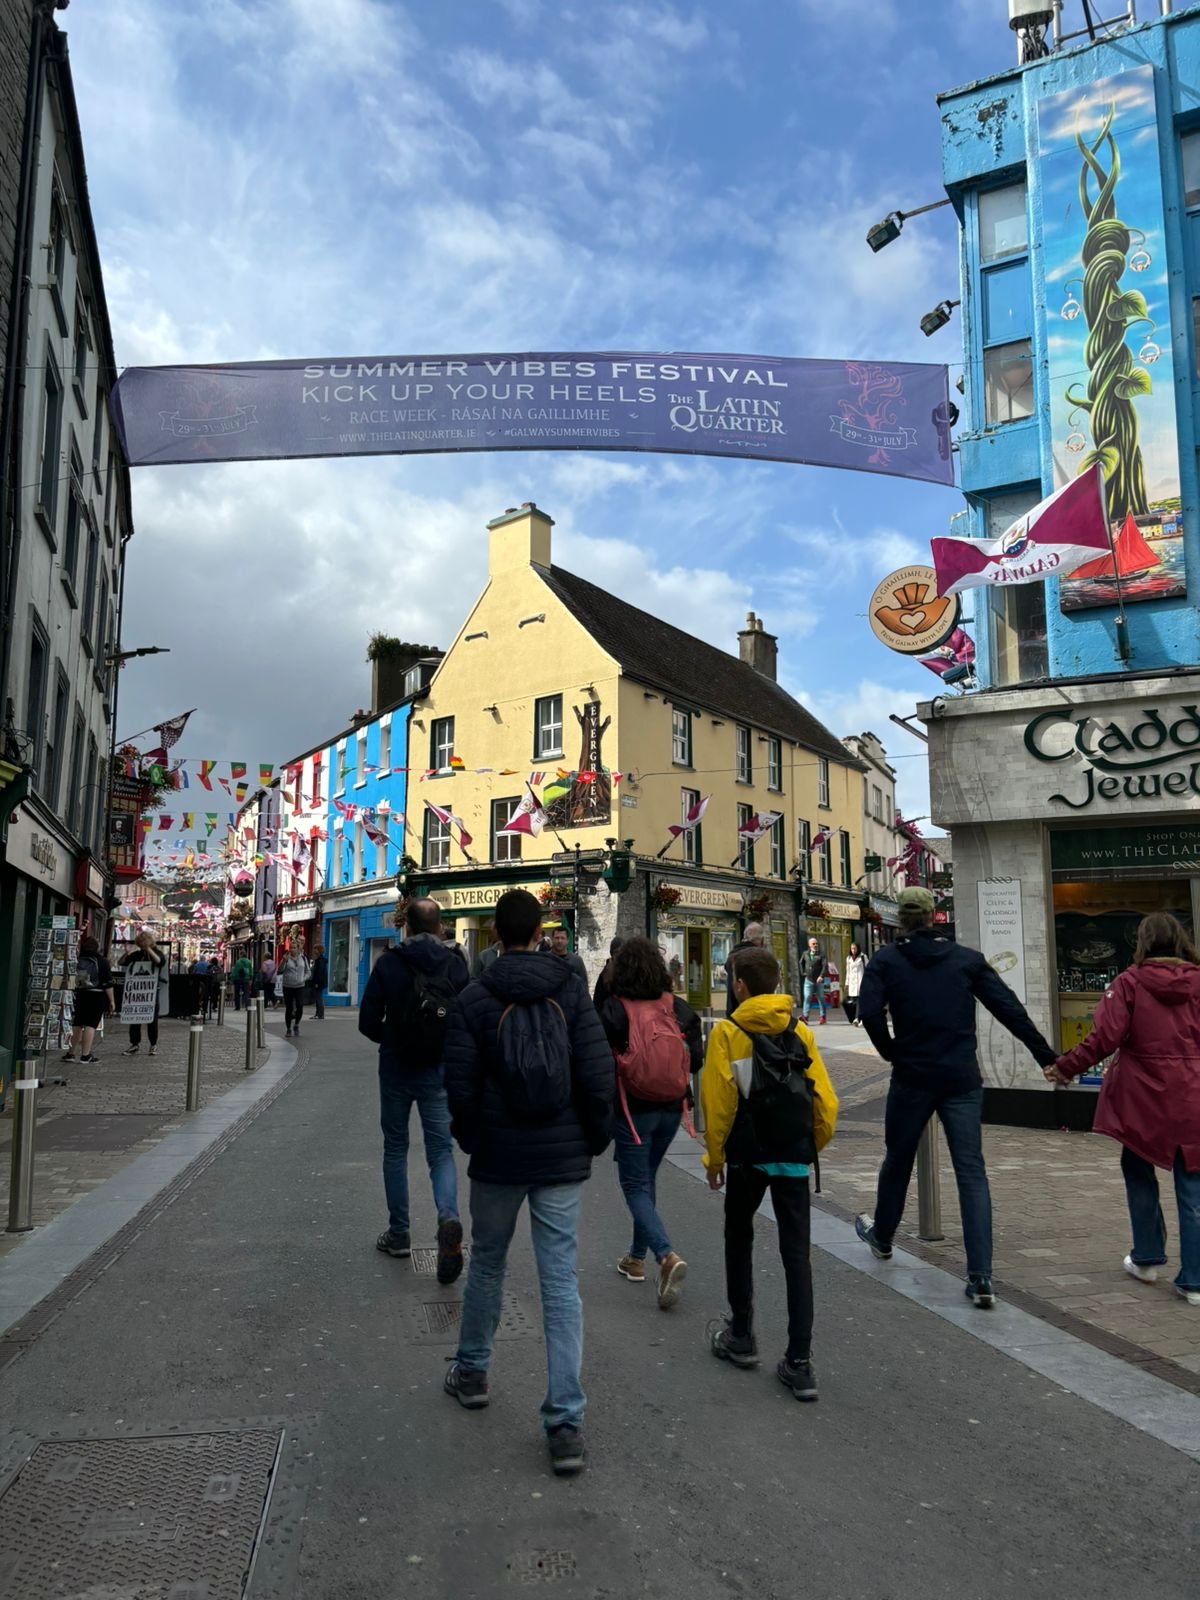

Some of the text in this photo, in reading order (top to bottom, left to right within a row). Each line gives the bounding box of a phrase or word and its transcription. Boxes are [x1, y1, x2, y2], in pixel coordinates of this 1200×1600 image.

[303, 361, 788, 387] SUMMER VIBES FESTIVAL
[302, 384, 657, 403] KICK UP YOUR HEELS
[668, 393, 694, 404] THE
[696, 389, 781, 417] LATIN
[350, 410, 389, 424] RACE
[393, 408, 437, 423] WEEK
[451, 406, 496, 421] RÁSAÍ
[501, 408, 523, 420] NA
[528, 408, 610, 421] GAILLIMHE
[669, 405, 787, 433] QUARTER
[339, 427, 620, 443] WWW.THELATINQUARTER.IE #GALWAYSUMMERVIBES
[883, 437, 902, 446] JULY
[880, 619, 949, 647] FROM GALWAY WITH LOVE
[1146, 832, 1174, 841] SHOP
[678, 887, 729, 907] EVERGREEN
[125, 980, 155, 992] GALWAY
[124, 991, 154, 1005] MARKET
